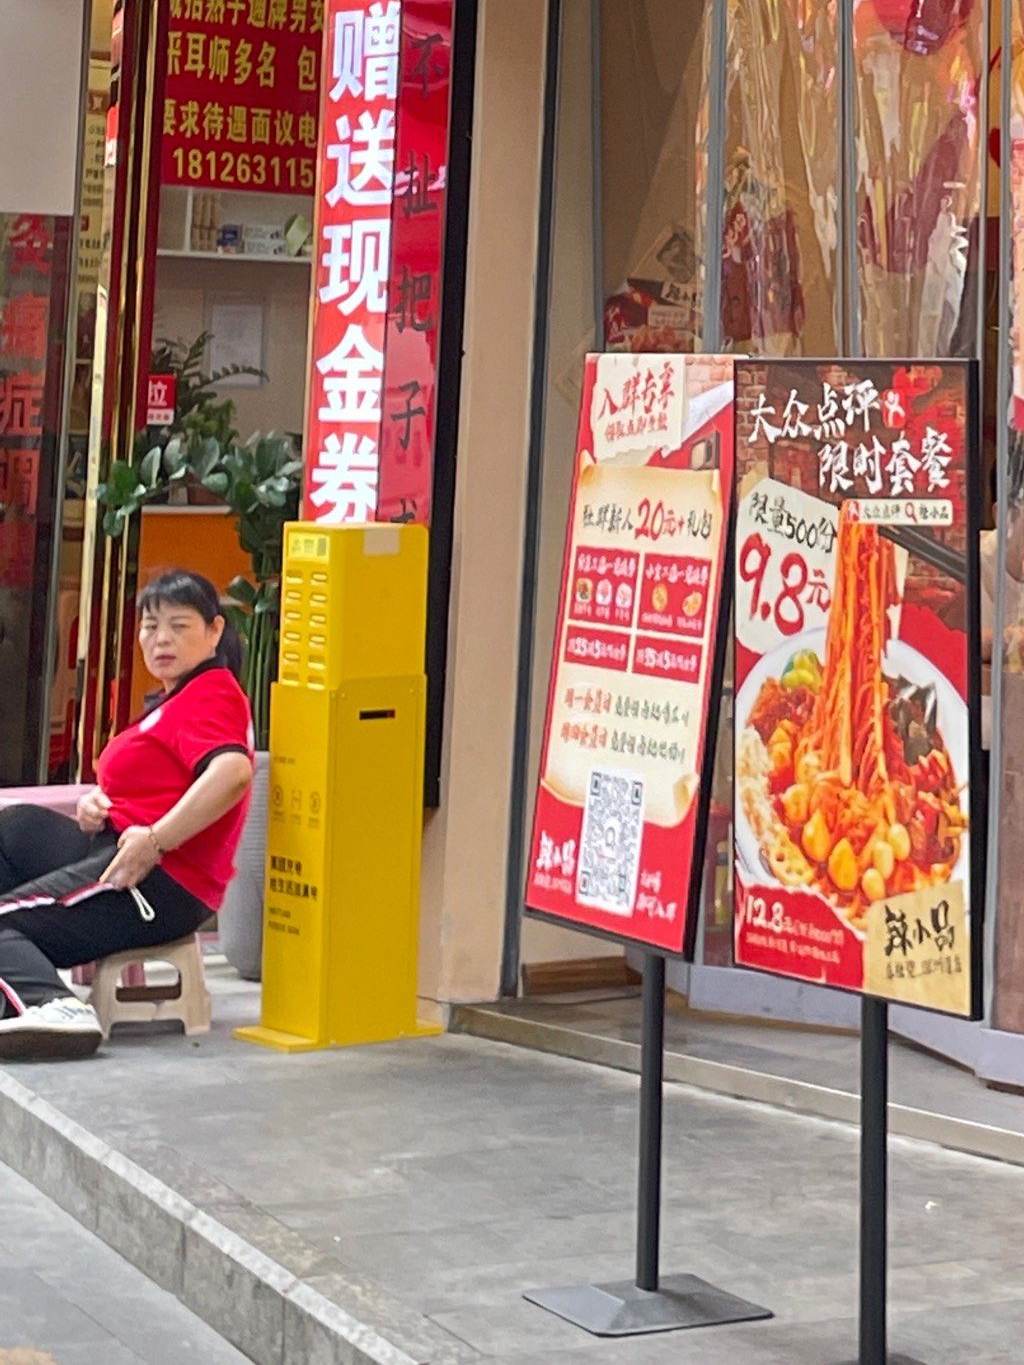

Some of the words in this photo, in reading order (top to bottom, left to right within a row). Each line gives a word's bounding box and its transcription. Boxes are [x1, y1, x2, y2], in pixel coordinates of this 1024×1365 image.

[297, 45, 317, 92] 包
[173, 146, 315, 189] 181263115
[748, 378, 881, 444] 大众点评
[817, 426, 952, 496] 限时套餐
[751, 491, 838, 554] 限量500份
[739, 531, 831, 636] 9.8元
[884, 899, 956, 957] 辣小品
